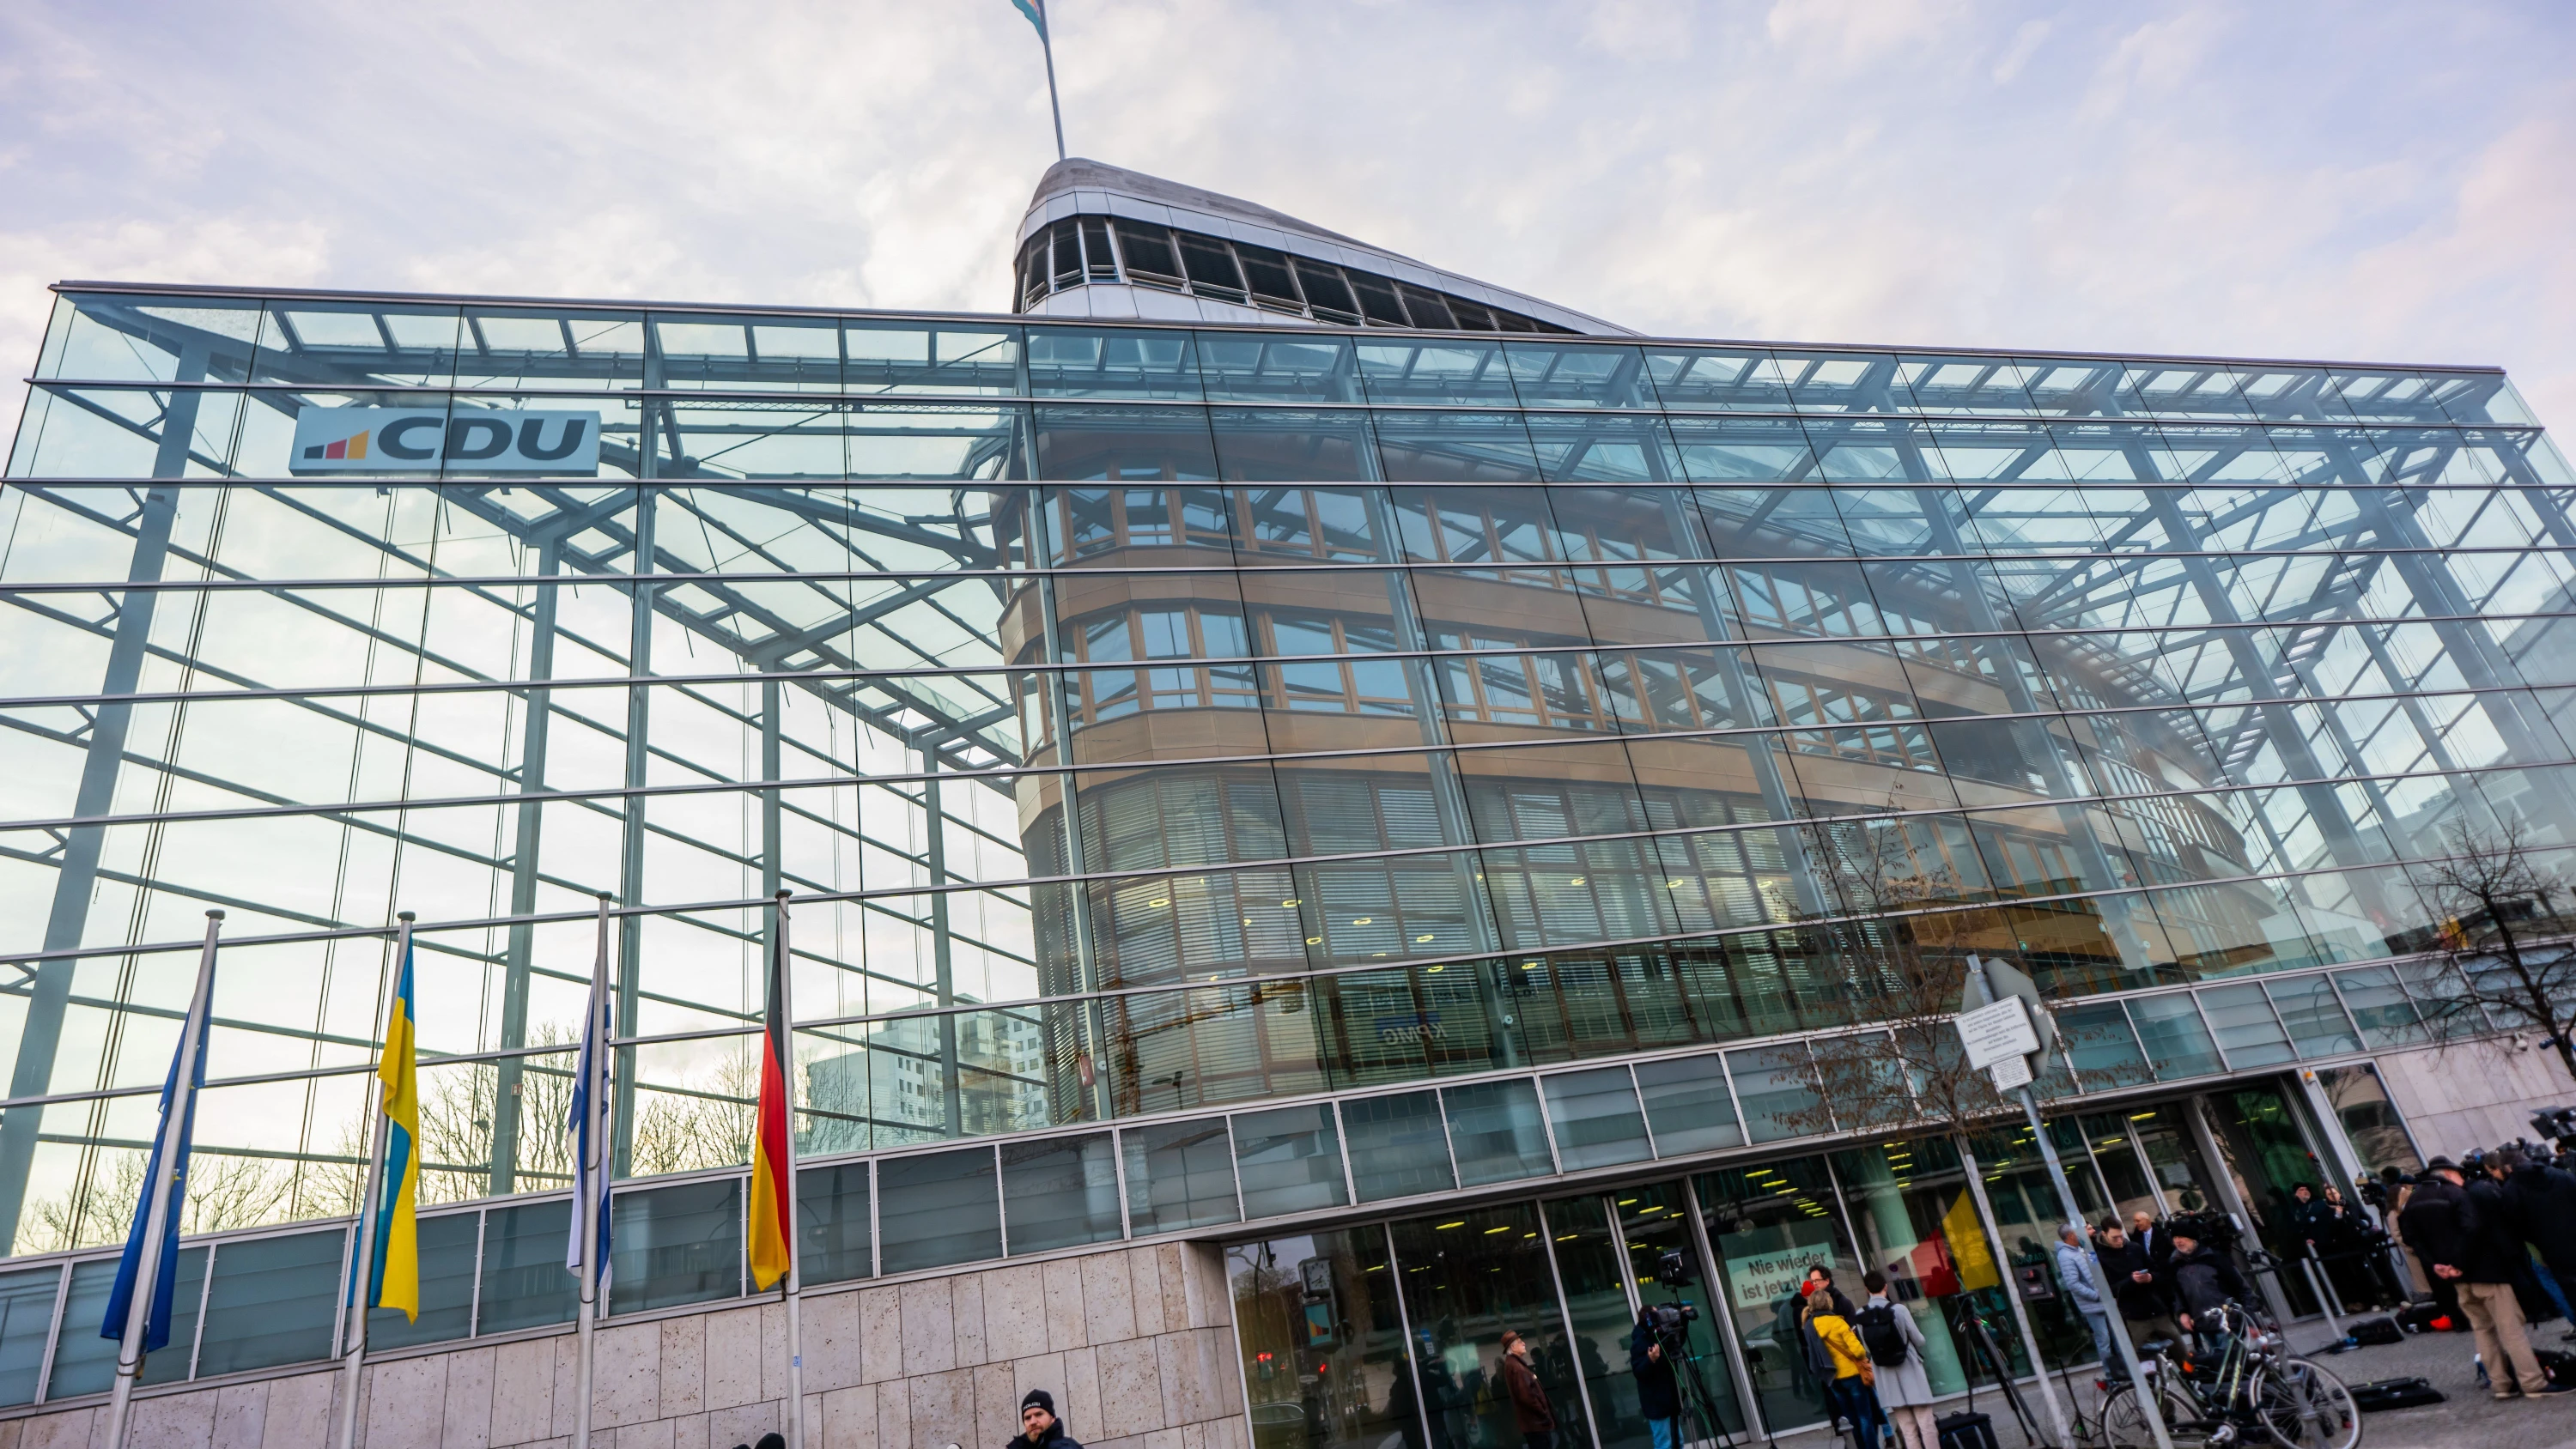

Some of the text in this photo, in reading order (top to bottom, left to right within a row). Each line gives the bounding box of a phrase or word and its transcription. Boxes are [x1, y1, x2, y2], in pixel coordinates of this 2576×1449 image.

[377, 416, 587, 461] CDU
[1748, 1252, 1826, 1276] Nie wieder
[1741, 1276, 1802, 1300] ist jetzt!
